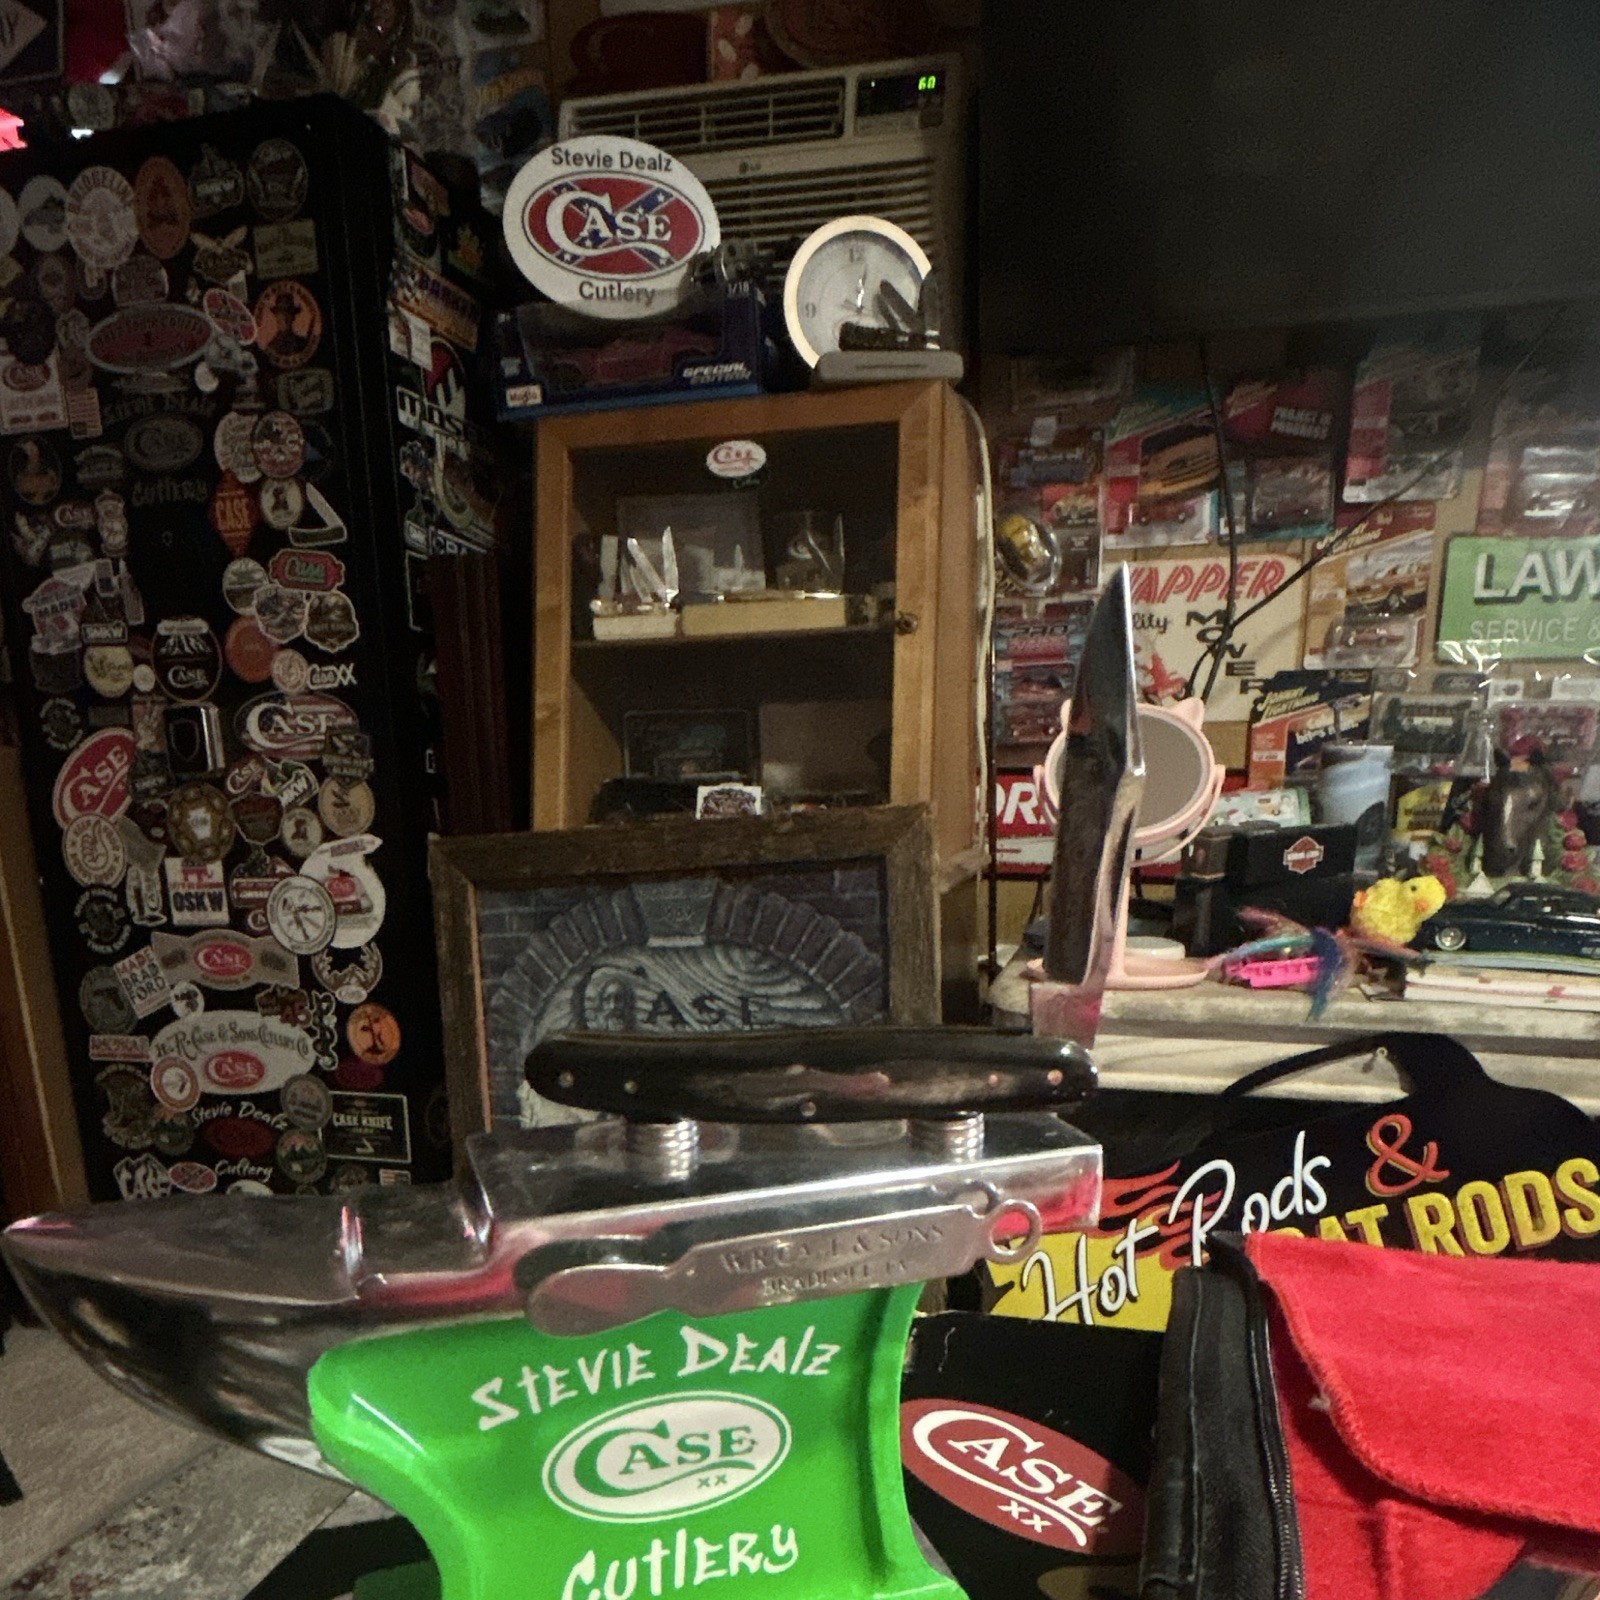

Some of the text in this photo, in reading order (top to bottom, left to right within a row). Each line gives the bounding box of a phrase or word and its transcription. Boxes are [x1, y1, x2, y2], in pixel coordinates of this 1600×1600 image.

[551, 147, 673, 172] Stevie Dealz
[546, 191, 673, 257] CASE
[579, 281, 655, 306] Cutlery
[216, 501, 250, 530] CASE
[1133, 613, 1168, 633] lity
[1469, 617, 1579, 644] SERVICE
[62, 744, 130, 822] CASE
[1022, 1111, 1451, 1326] Hot Rods &
[1278, 1157, 1600, 1257] AT RODS
[573, 1418, 760, 1498] CASE
[912, 1410, 1124, 1547] CASE
